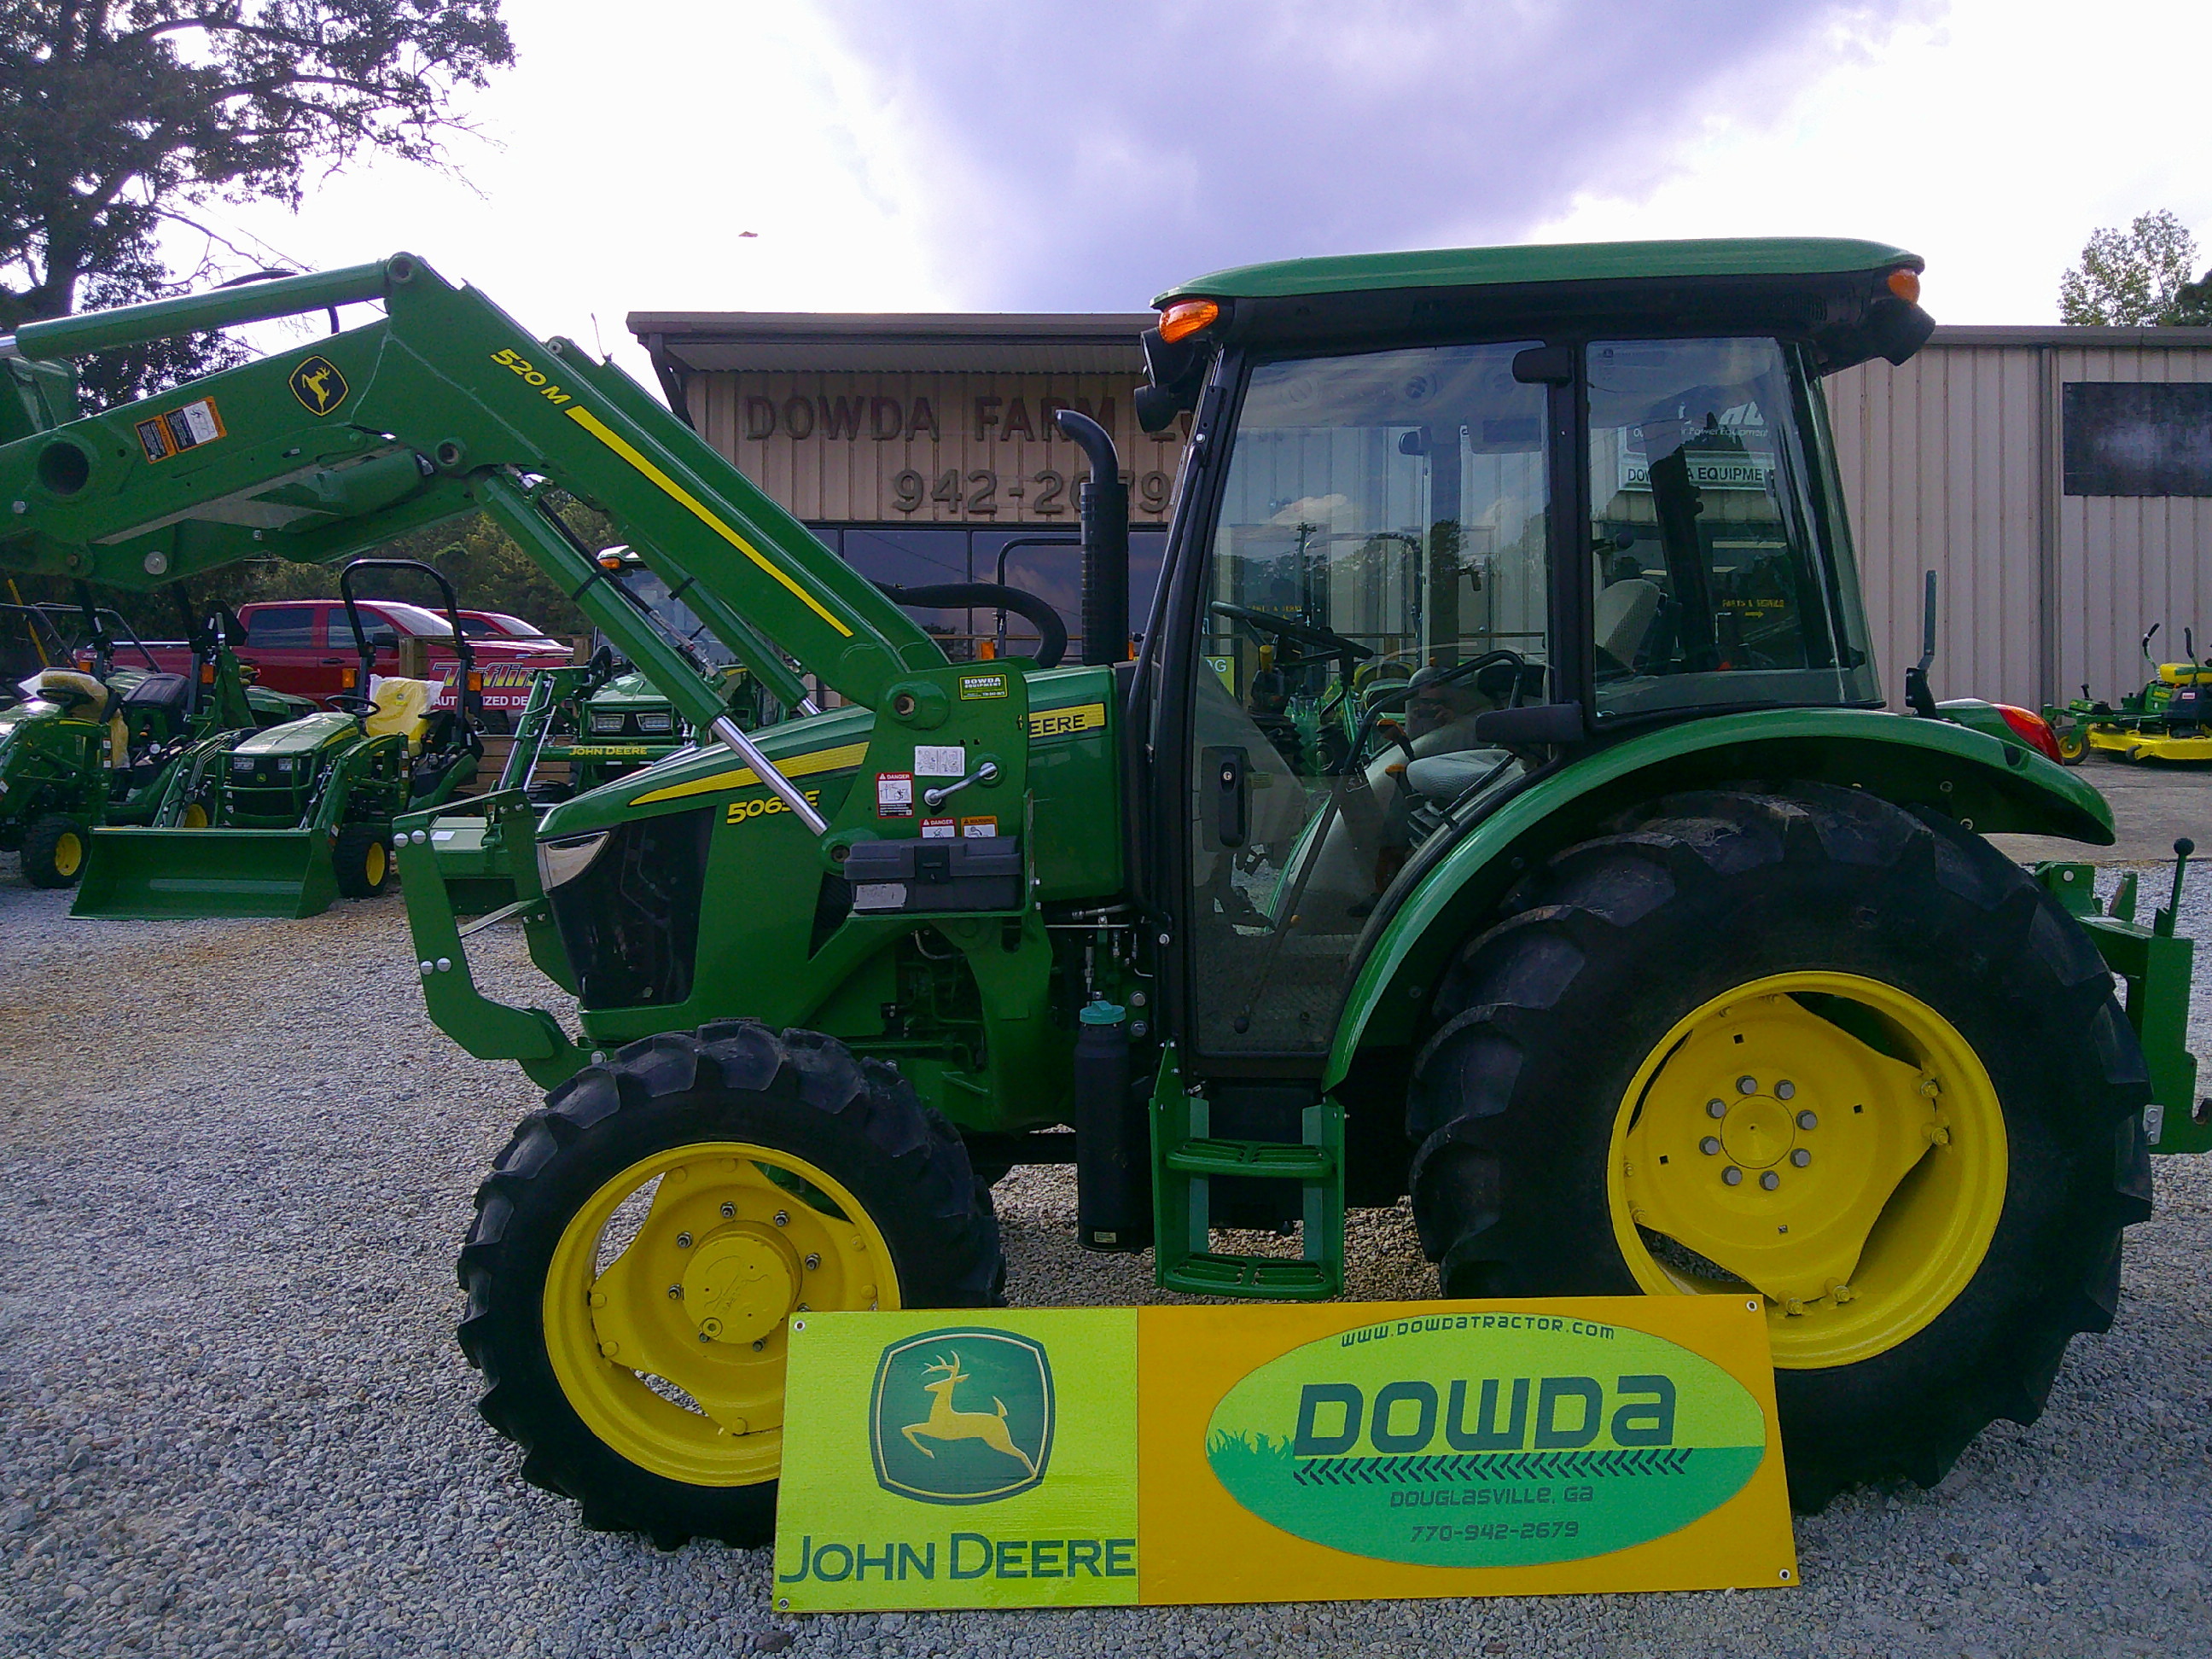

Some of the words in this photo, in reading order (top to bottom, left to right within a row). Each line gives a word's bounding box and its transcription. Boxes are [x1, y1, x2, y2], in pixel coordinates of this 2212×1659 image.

[747, 395, 940, 442] DOWDA
[975, 398, 1115, 442] FARM
[568, 747, 602, 756] JOHN
[605, 746, 648, 755] DEERE
[1411, 1521, 1579, 1543] 770-942-2679
[779, 1535, 935, 1583] JOHN
[950, 1532, 1137, 1580] DEERE
